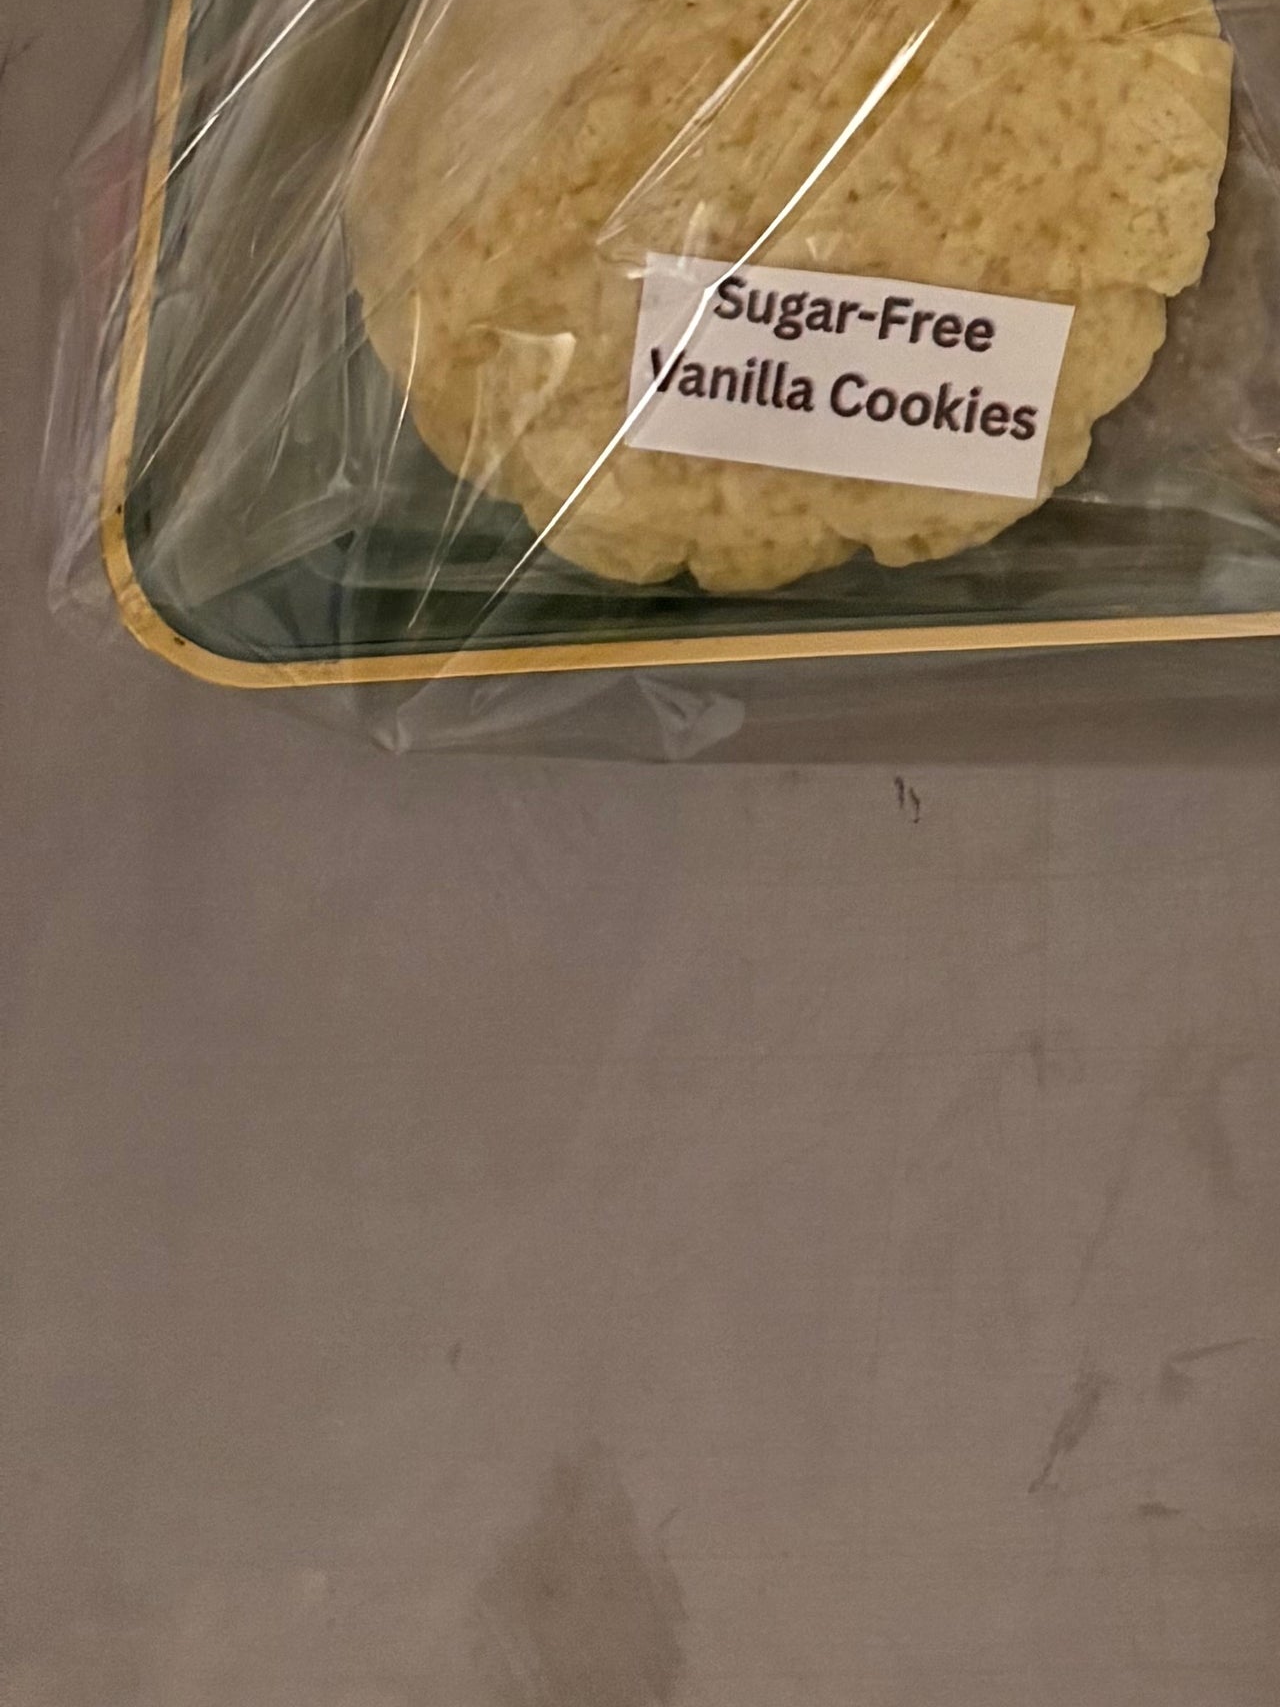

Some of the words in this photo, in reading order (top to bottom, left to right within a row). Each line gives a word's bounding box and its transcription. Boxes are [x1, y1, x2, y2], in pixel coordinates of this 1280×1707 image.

[713, 276, 997, 353] Sugar-Free
[650, 347, 815, 413] Vanilla
[829, 371, 1039, 441] Cookies
